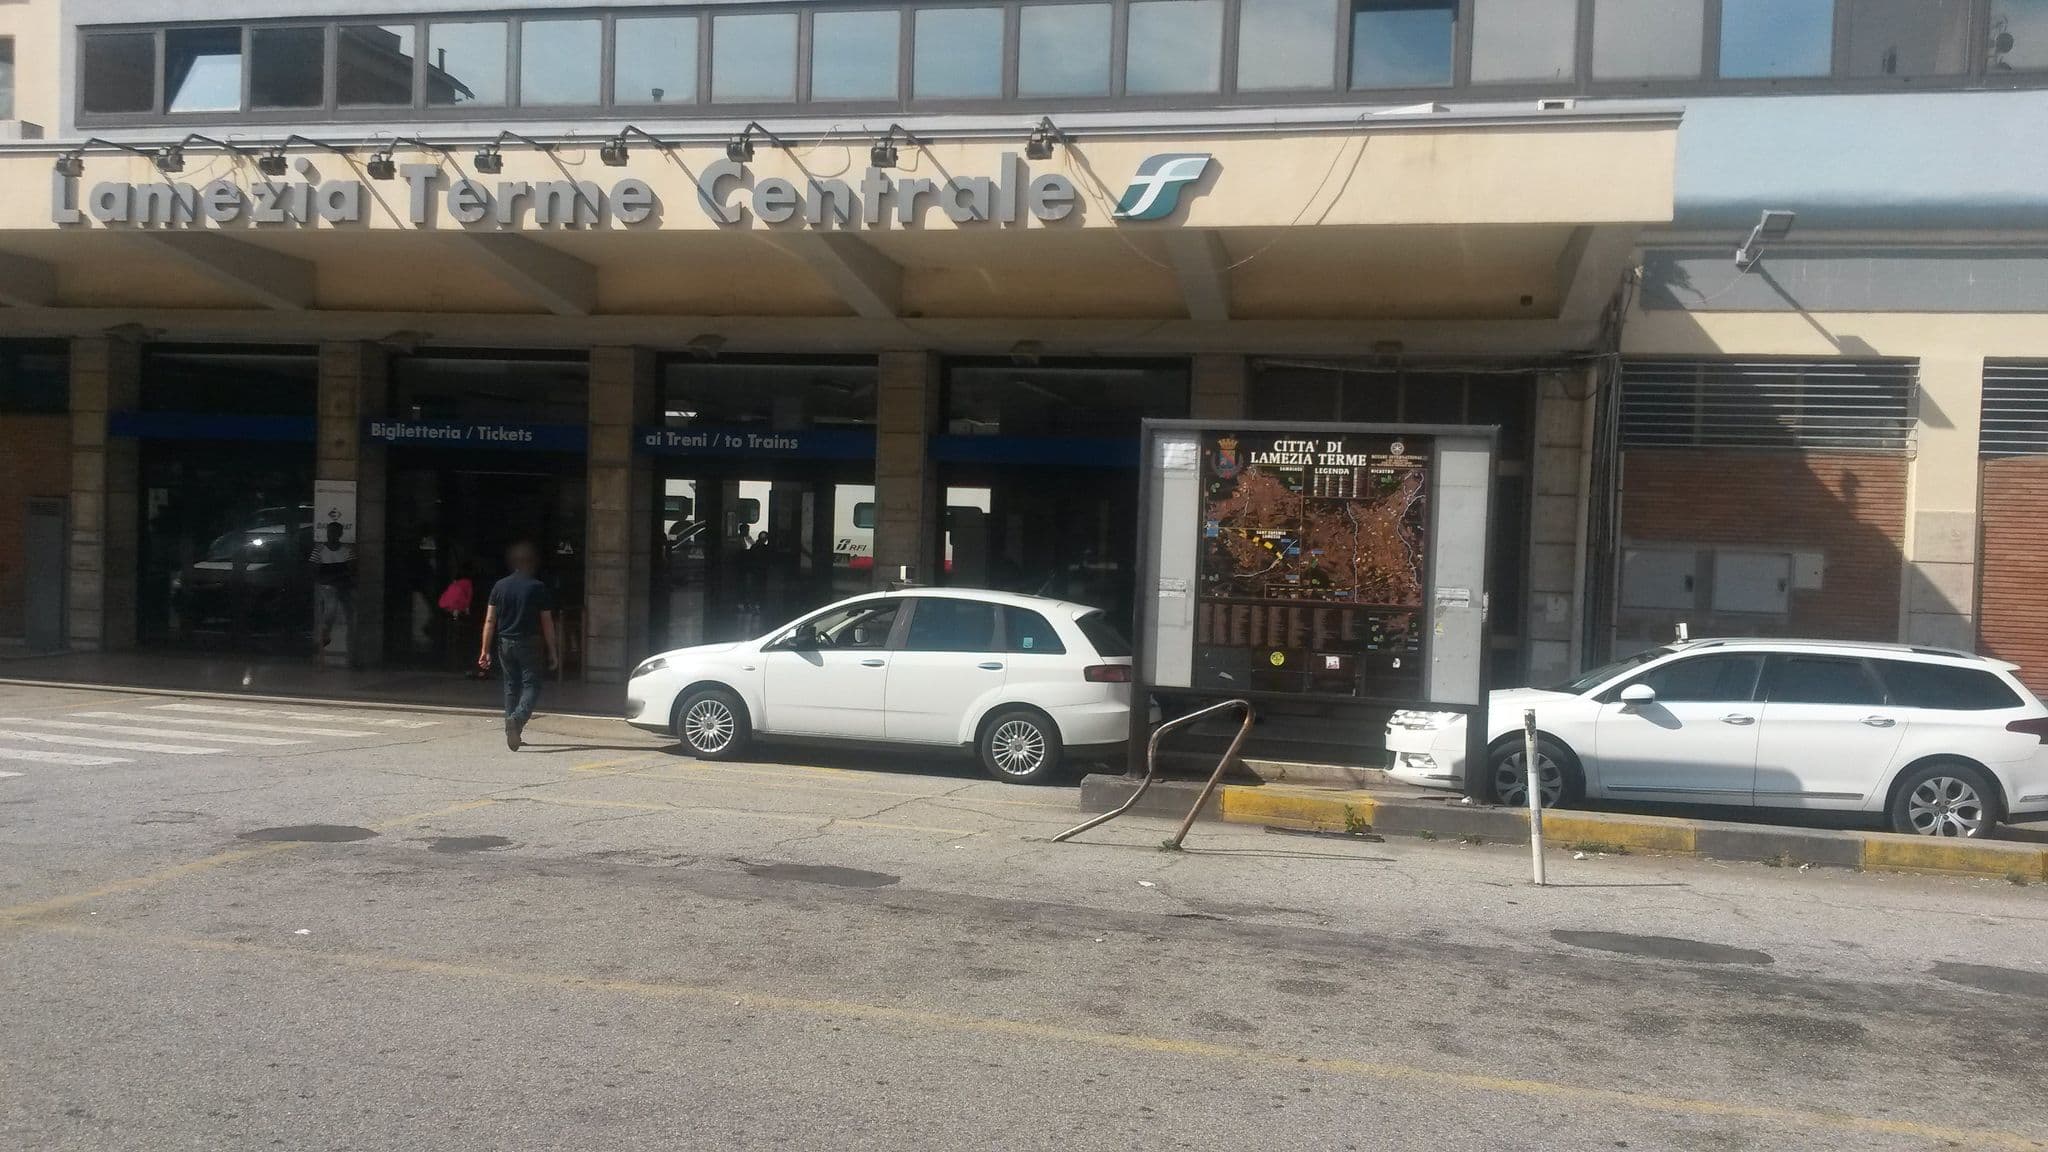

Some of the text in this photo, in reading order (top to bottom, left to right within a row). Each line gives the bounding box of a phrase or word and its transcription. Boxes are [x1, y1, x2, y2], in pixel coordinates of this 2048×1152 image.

[52, 152, 1075, 224] Lamezia Terme Centrale
[371, 422, 533, 442] Biglietteria / Tickets
[645, 432, 799, 449] ai Treni / to Trains
[1273, 440, 1342, 453] CITTA' DI
[1250, 452, 1313, 465] LAMEZIA
[1317, 454, 1367, 467] TERME
[1314, 467, 1350, 475] LEGENDA
